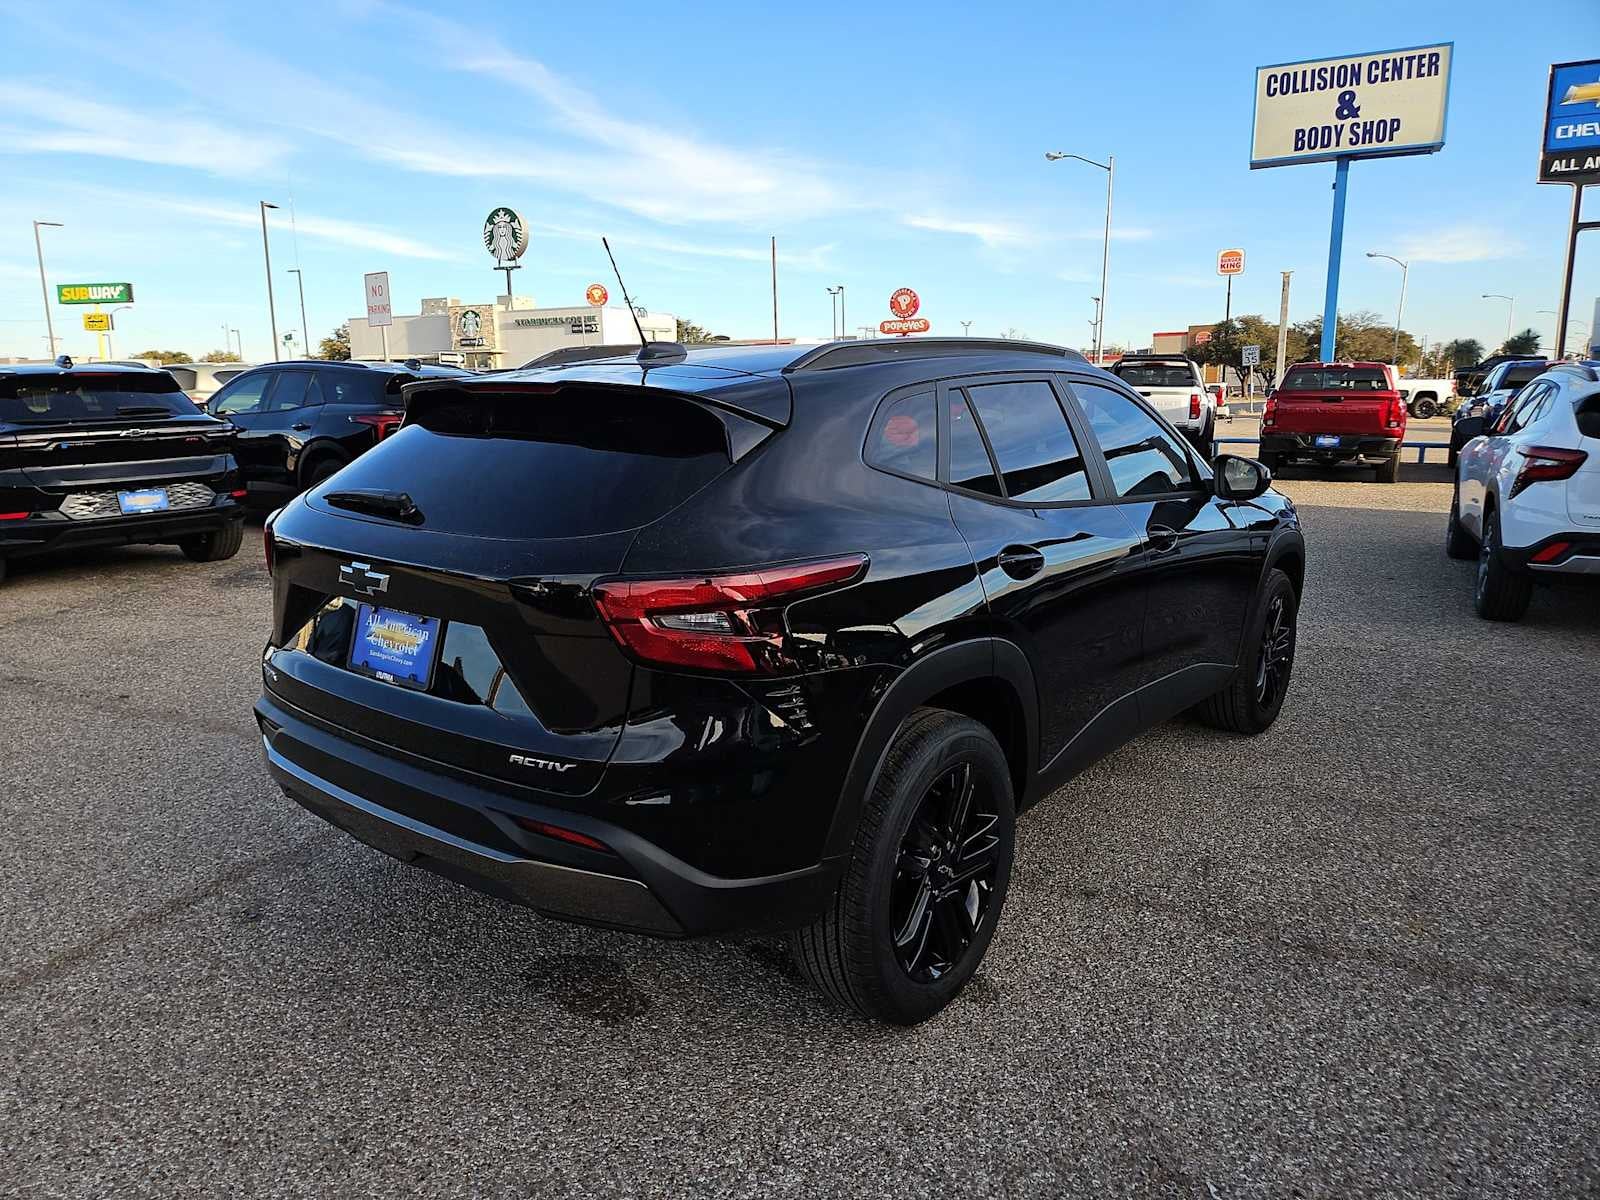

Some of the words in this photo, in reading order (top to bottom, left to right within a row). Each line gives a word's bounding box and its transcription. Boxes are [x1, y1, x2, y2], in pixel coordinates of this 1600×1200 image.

[1266, 62, 1362, 98] COLLISION
[1367, 52, 1440, 84] CENTER
[1335, 90, 1360, 121] &
[1294, 124, 1345, 152] BODY
[1349, 118, 1401, 146] SHOP
[1550, 158, 1580, 172] ALL
[61, 285, 125, 301] SUBWAY
[371, 284, 383, 297] NO
[368, 303, 390, 314] PARKING
[514, 316, 565, 327] STARBUCKS
[1244, 355, 1258, 364] 35
[366, 613, 381, 627] All
[383, 617, 429, 641] American
[370, 631, 418, 657] Chevrolet
[508, 754, 577, 772] ACTIV
